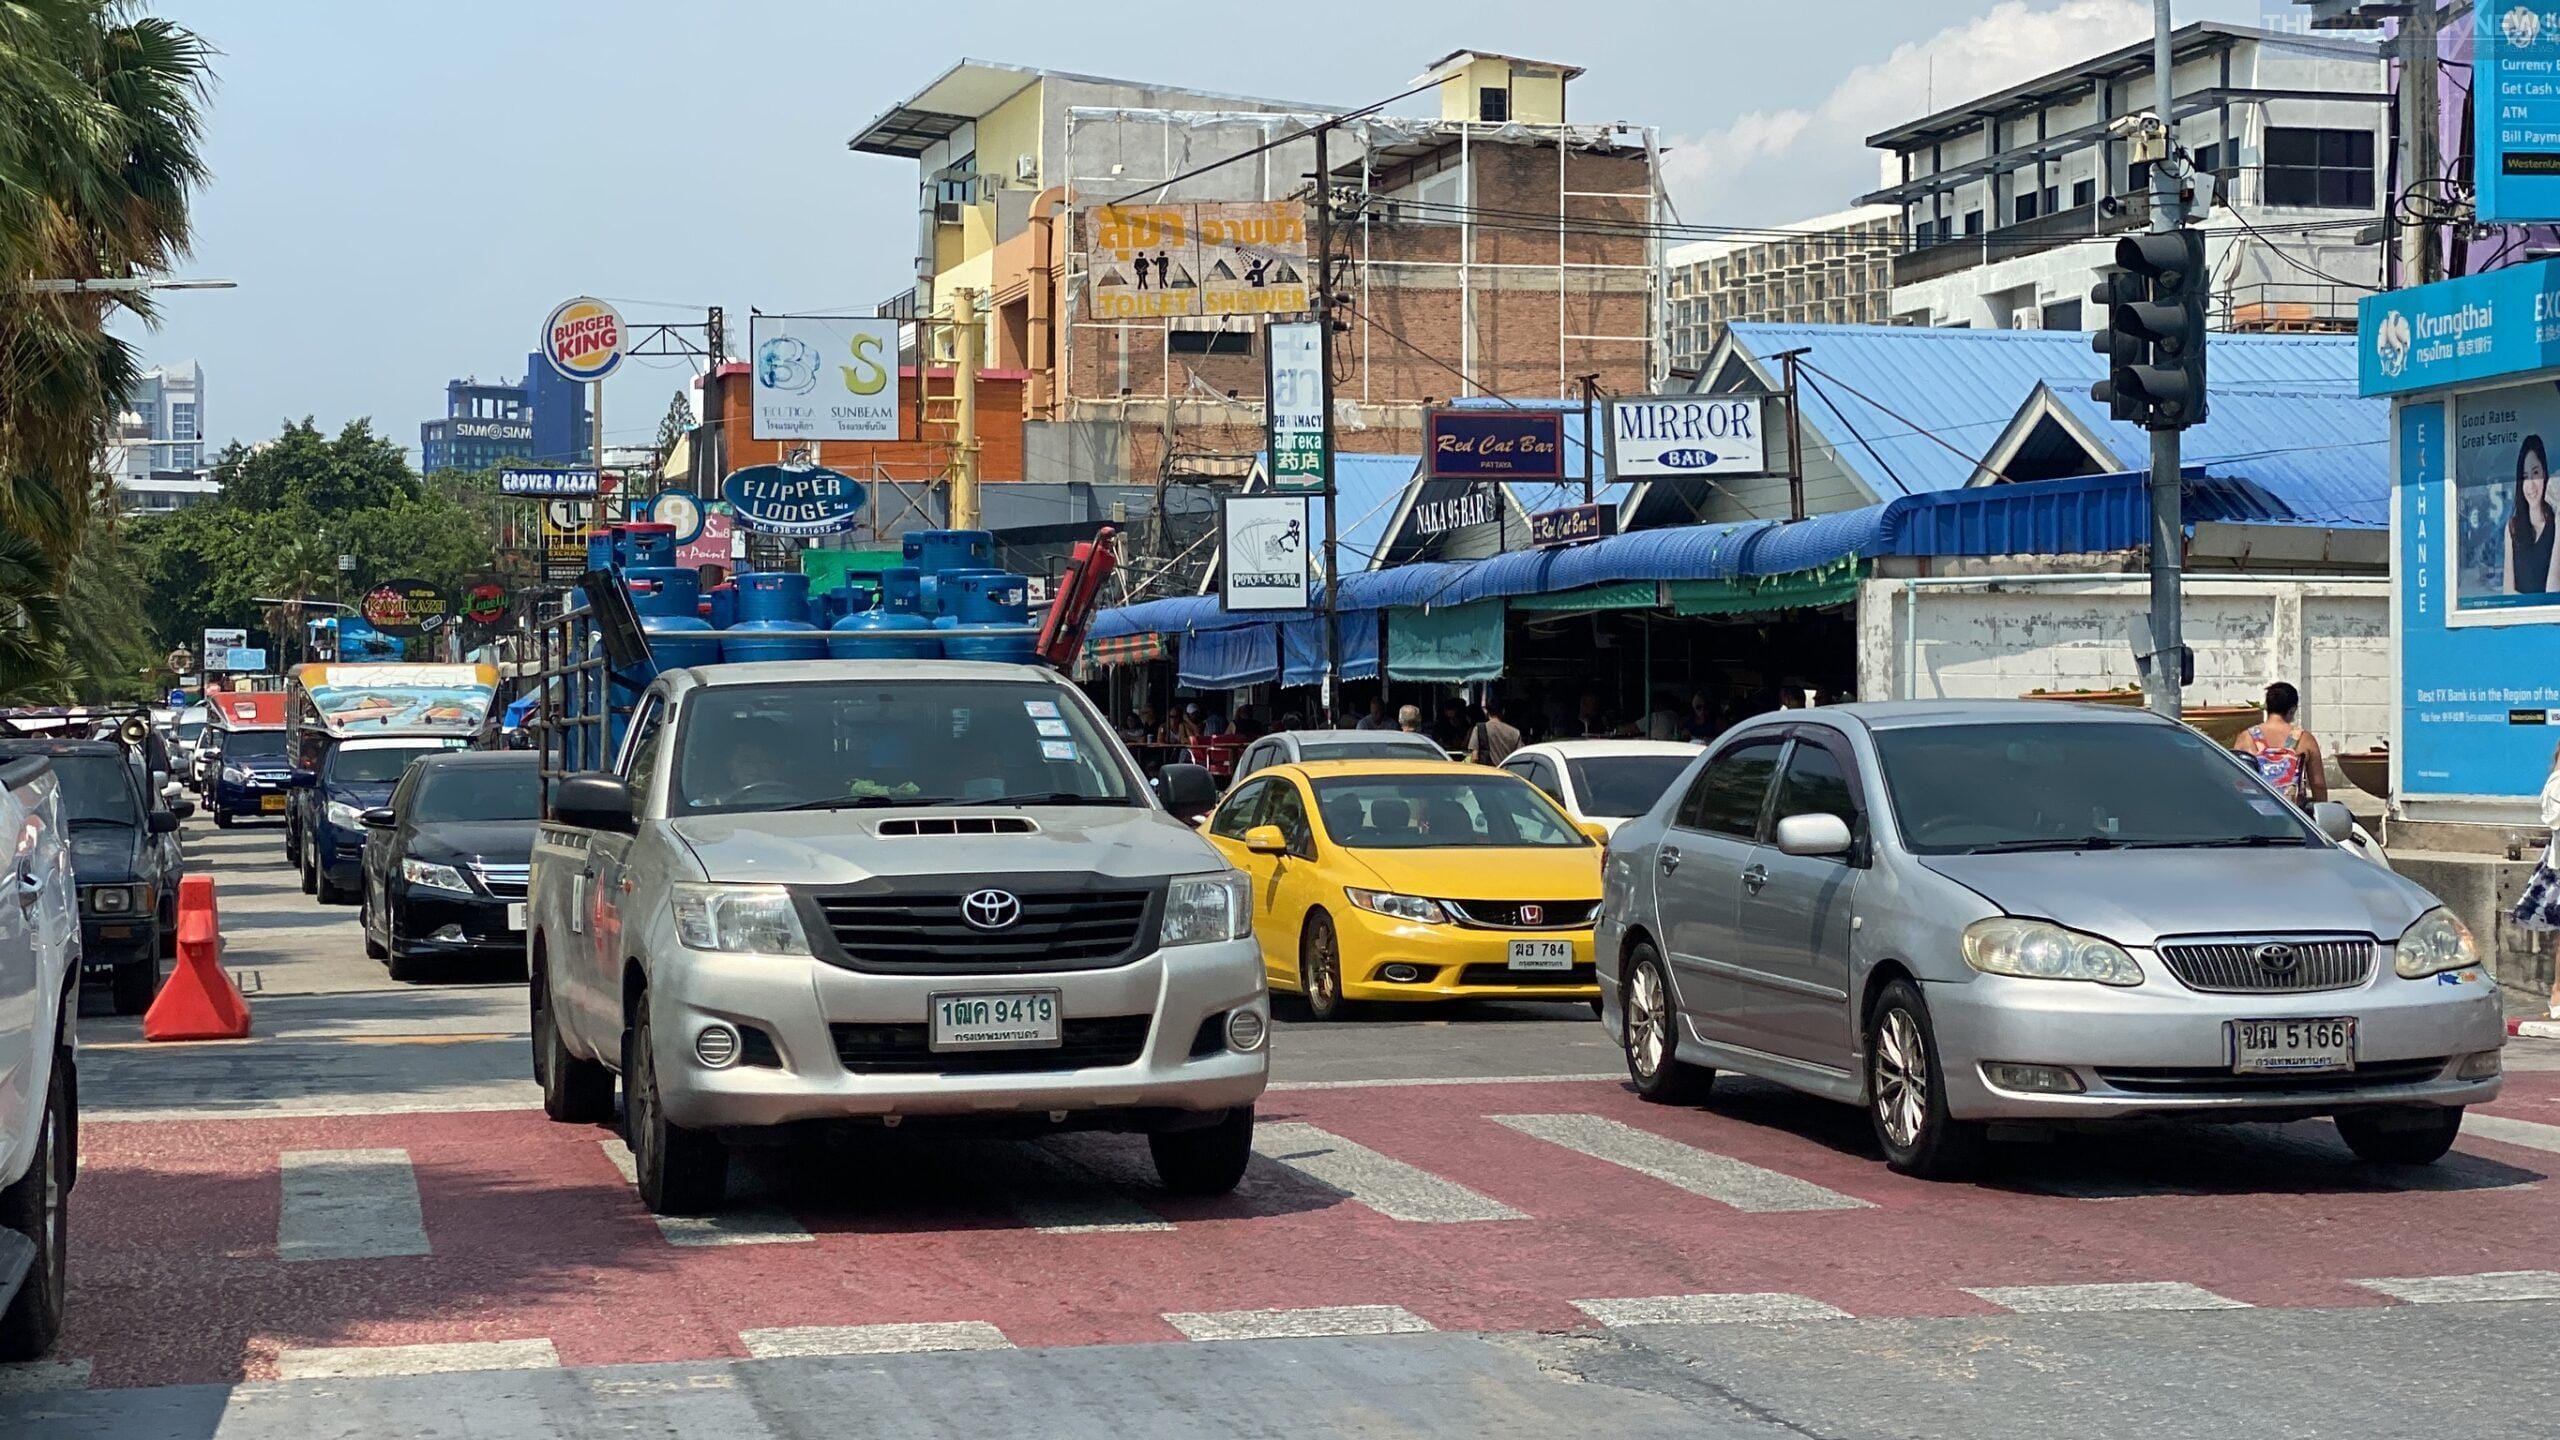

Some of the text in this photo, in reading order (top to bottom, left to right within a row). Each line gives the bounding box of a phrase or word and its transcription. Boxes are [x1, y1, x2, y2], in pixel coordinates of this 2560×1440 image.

[2502, 58, 2552, 73] Currency
[2502, 82, 2522, 95] Get
[2525, 81, 2552, 95] Cash
[2502, 106, 2528, 119] ATM
[2502, 130, 2521, 143] Bill
[1098, 293, 1190, 315] TOILET
[1205, 288, 1306, 313] SHOWER
[555, 315, 614, 343] BURGER
[2416, 300, 2493, 340] Krungthai
[558, 328, 617, 363] KING
[2416, 340, 2453, 368] กรุงไทย
[831, 406, 893, 418] SUNBEAM
[2462, 412, 2485, 428] Good
[457, 423, 532, 440] SIAM@SIAM
[1618, 403, 1753, 441] MIRROR
[1437, 434, 1555, 456] Red Cat Bar
[2462, 431, 2518, 449] Great Service
[1277, 451, 1320, 471] 药店
[1480, 461, 1513, 469] PATTAYA
[1667, 451, 1707, 467] BAR
[556, 474, 598, 491] PLAZA
[743, 479, 841, 502] FLIPPER
[752, 500, 831, 522] LODGE
[1415, 493, 1485, 535] NAKA 95 BAR
[2418, 423, 2427, 613] EXCHANGE
[752, 523, 769, 533] Tel:
[1541, 517, 1557, 540] Red
[1557, 514, 1572, 540] Cat
[1572, 511, 1587, 535] Bar
[690, 545, 726, 560] Point
[1233, 574, 1300, 587] POKER BAR
[2418, 686, 2559, 704] Best FX Bank is in the Region of the
[1542, 943, 1564, 957] 784
[995, 998, 1051, 1023] 9419
[2287, 1023, 2344, 1049] 5166
